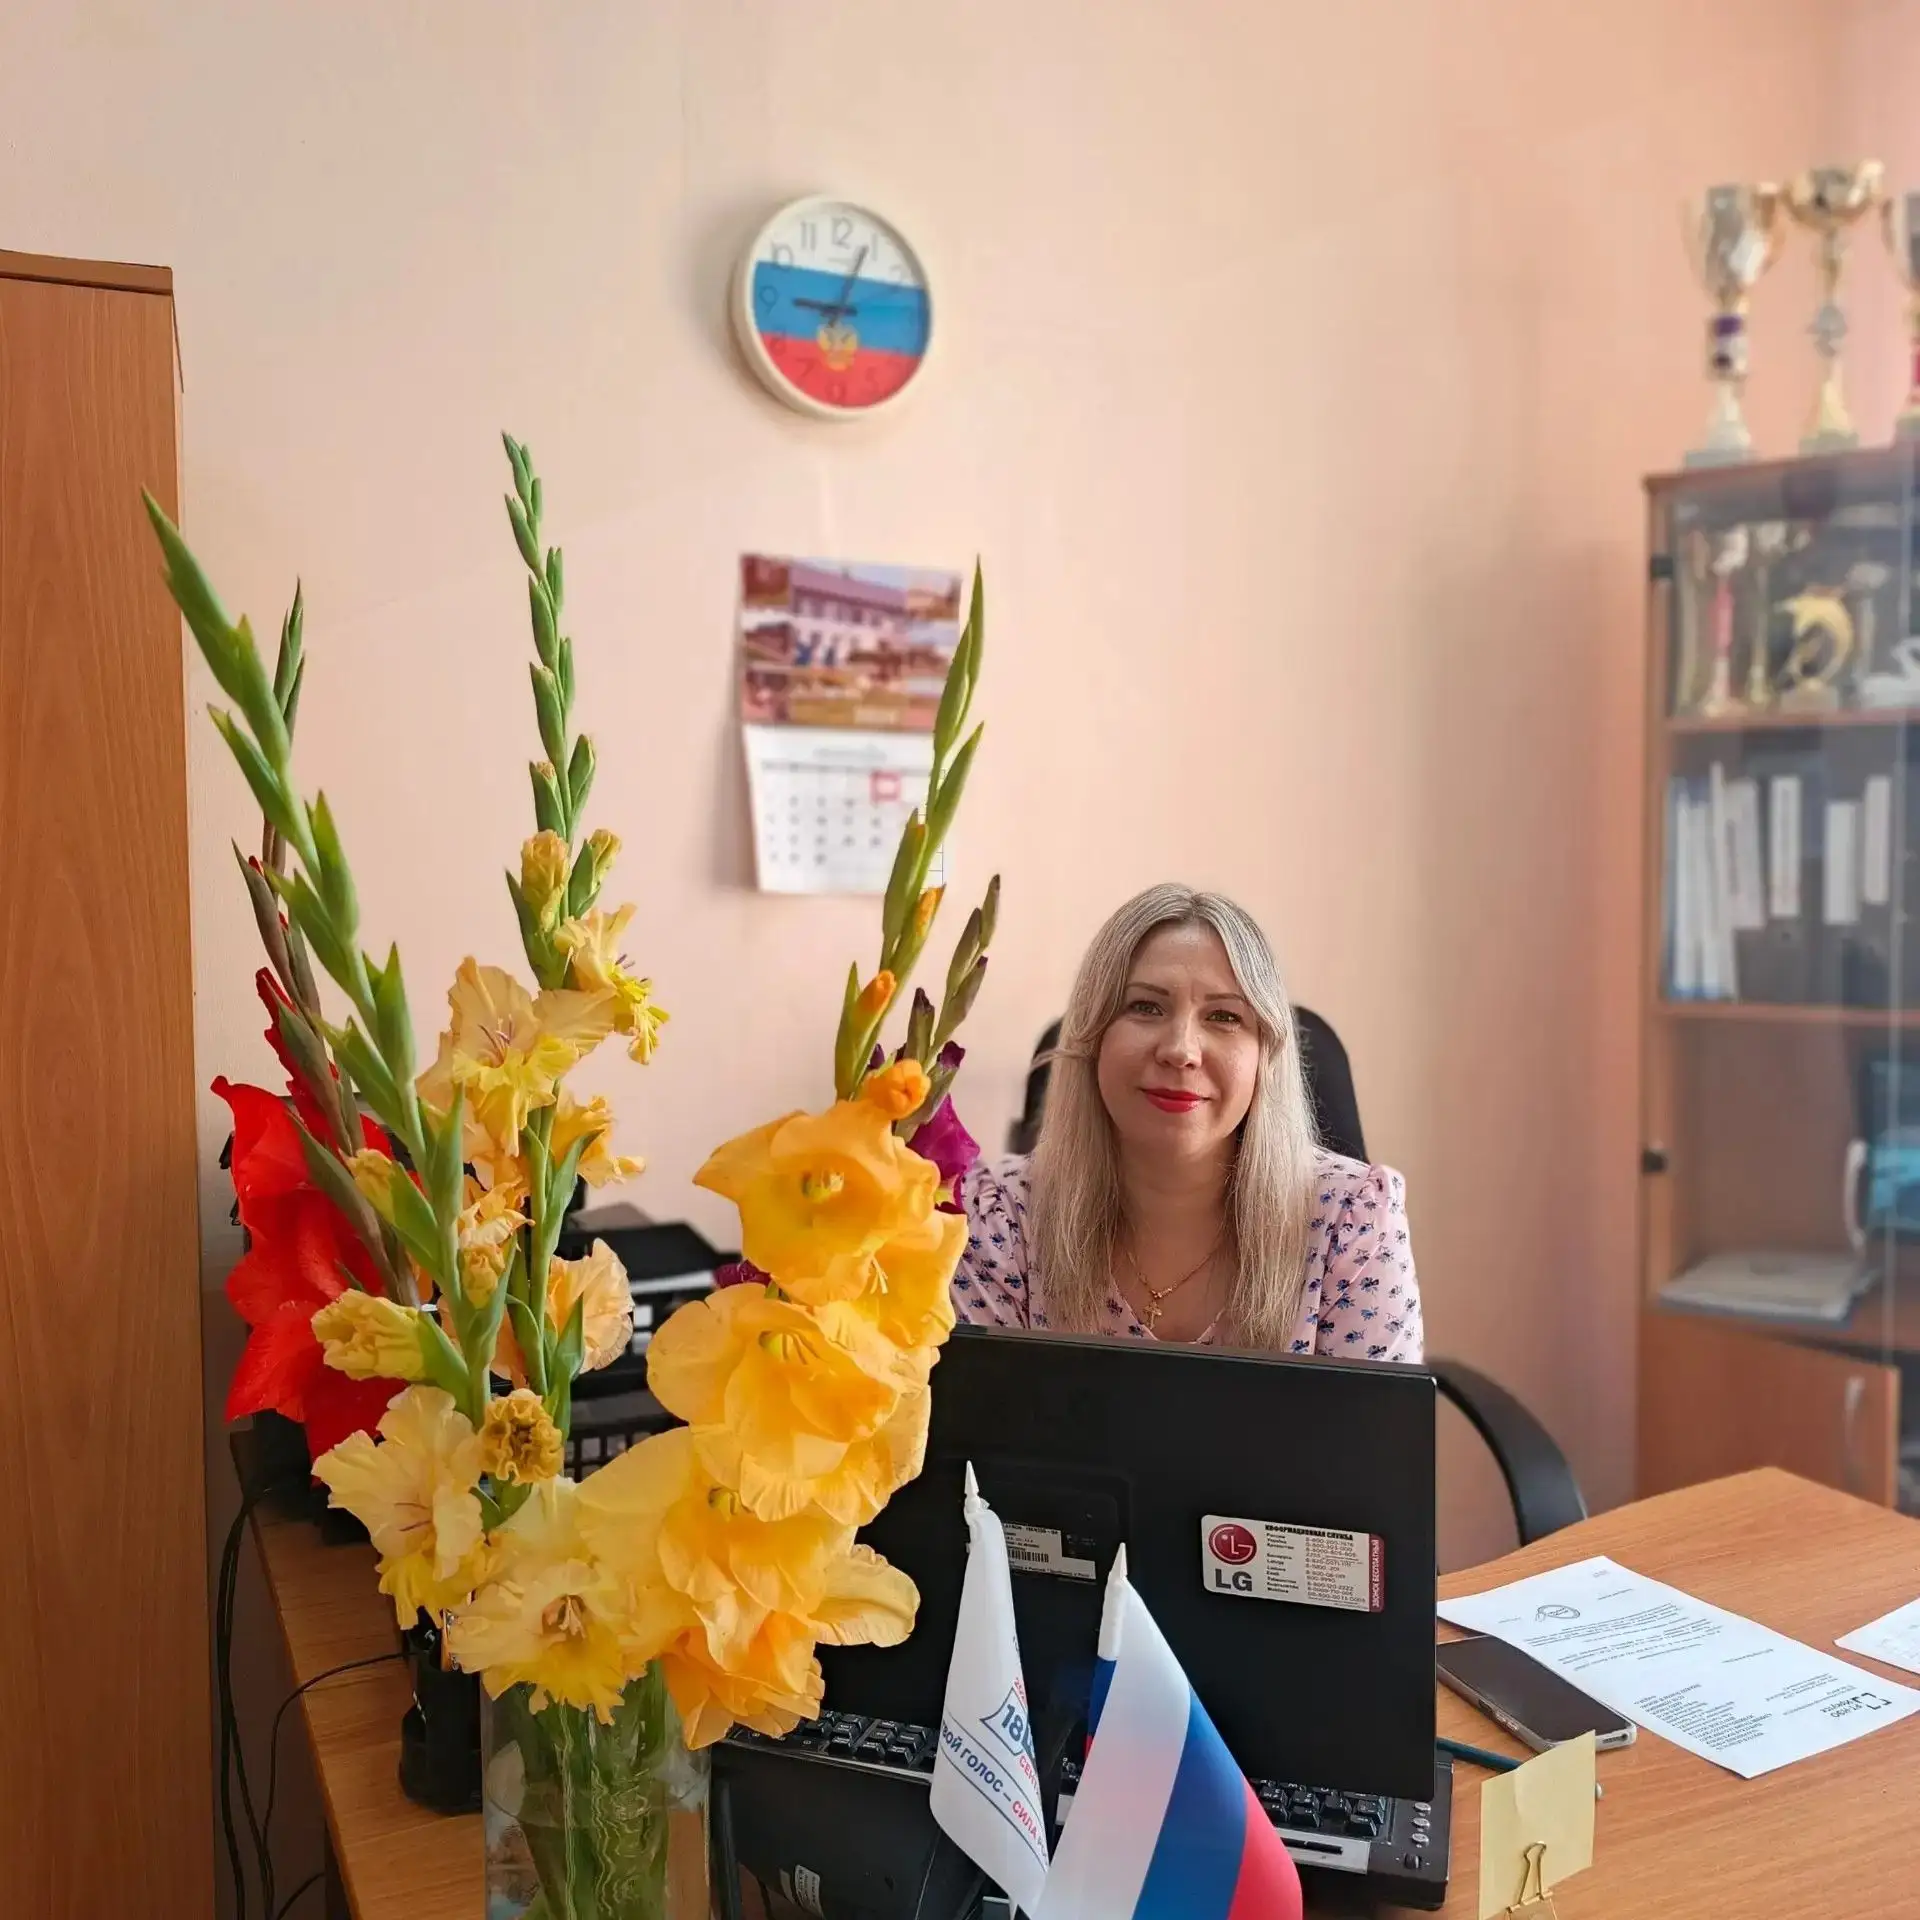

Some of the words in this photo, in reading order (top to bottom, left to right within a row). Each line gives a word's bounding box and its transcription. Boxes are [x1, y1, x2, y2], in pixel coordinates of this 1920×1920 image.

[800, 220, 816, 251] 11
[831, 216, 853, 249] 12
[1214, 1568, 1253, 1592] LG
[1001, 1704, 1024, 1742] 18
[960, 1748, 1004, 1793] ГОЛОС
[1012, 1800, 1038, 1840] СИЛА
